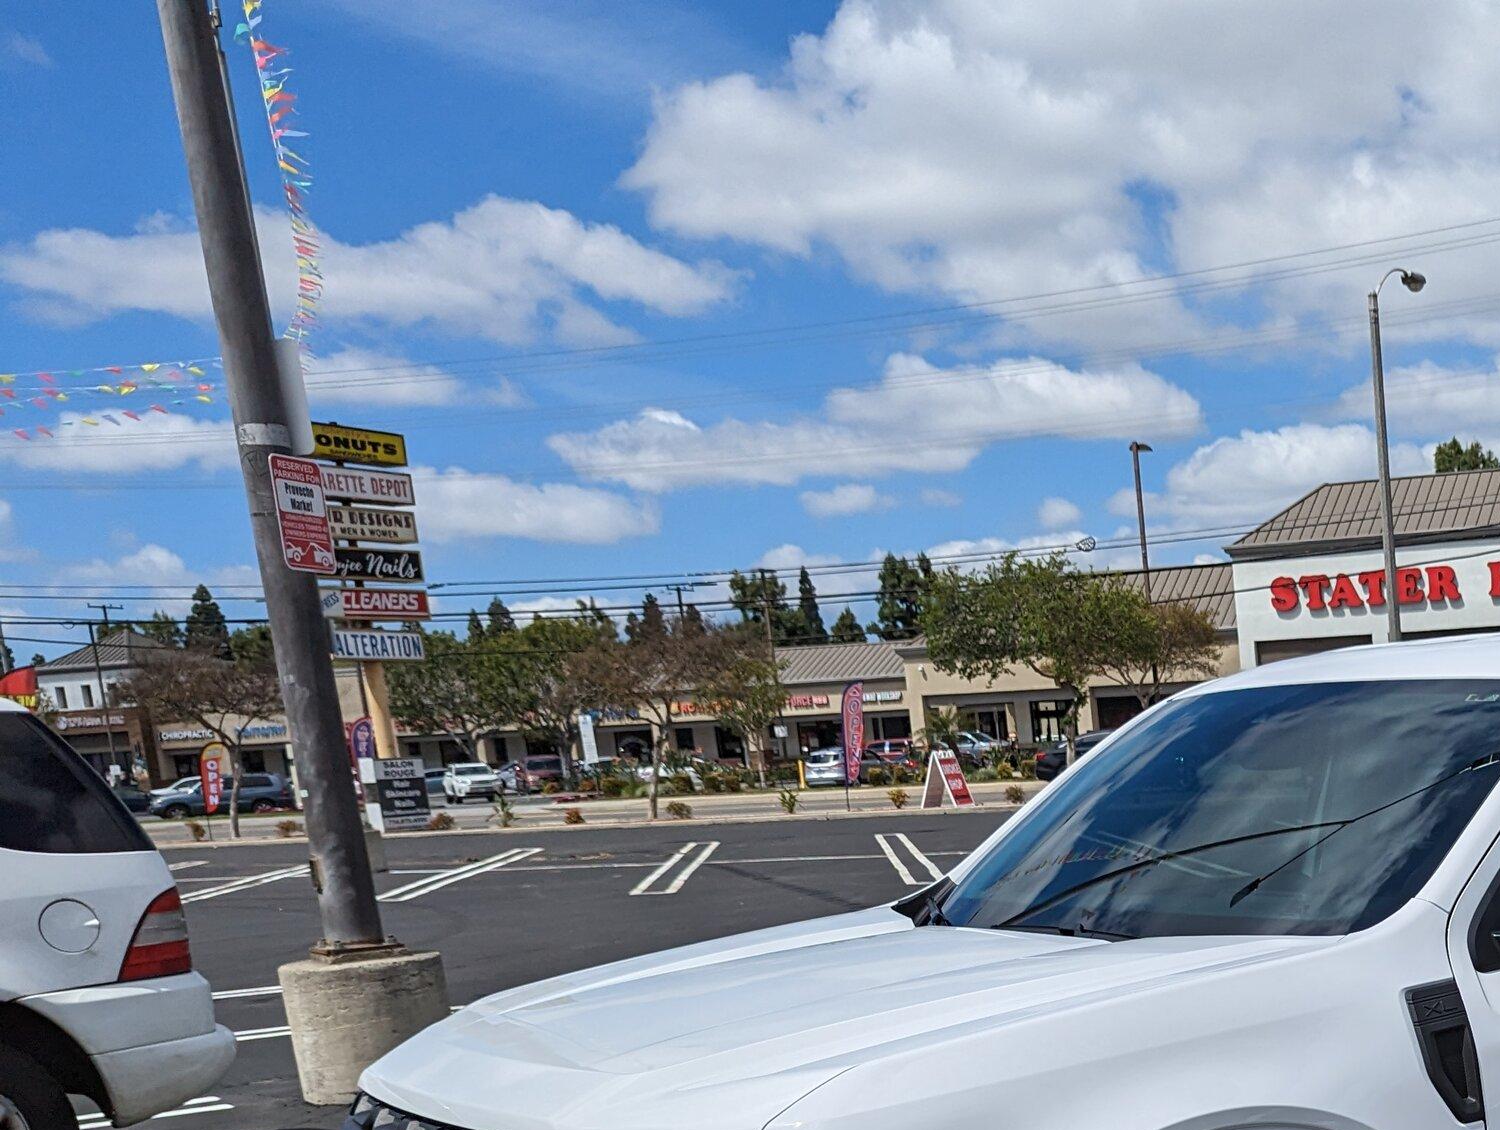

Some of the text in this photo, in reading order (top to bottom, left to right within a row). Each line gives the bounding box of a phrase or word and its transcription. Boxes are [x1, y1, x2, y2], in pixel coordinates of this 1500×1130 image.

[315, 433, 397, 455] ONUTS
[276, 459, 314, 474] RESERVED
[273, 469, 321, 485] PARKING FOR
[370, 476, 408, 498] DEPOT
[290, 498, 314, 512] Market
[349, 511, 412, 529] DESIGNS
[340, 526, 358, 536] MEN
[369, 528, 400, 538] WOMEN
[337, 553, 418, 579] ujee Nails
[1271, 565, 1462, 612] STATER
[342, 591, 419, 611] CLEANERS
[335, 633, 423, 658] ALTERATION
[161, 729, 213, 740] CHIROPRACTIC
[206, 760, 220, 806] OPEN
[1423, 1000, 1459, 1017] XL
